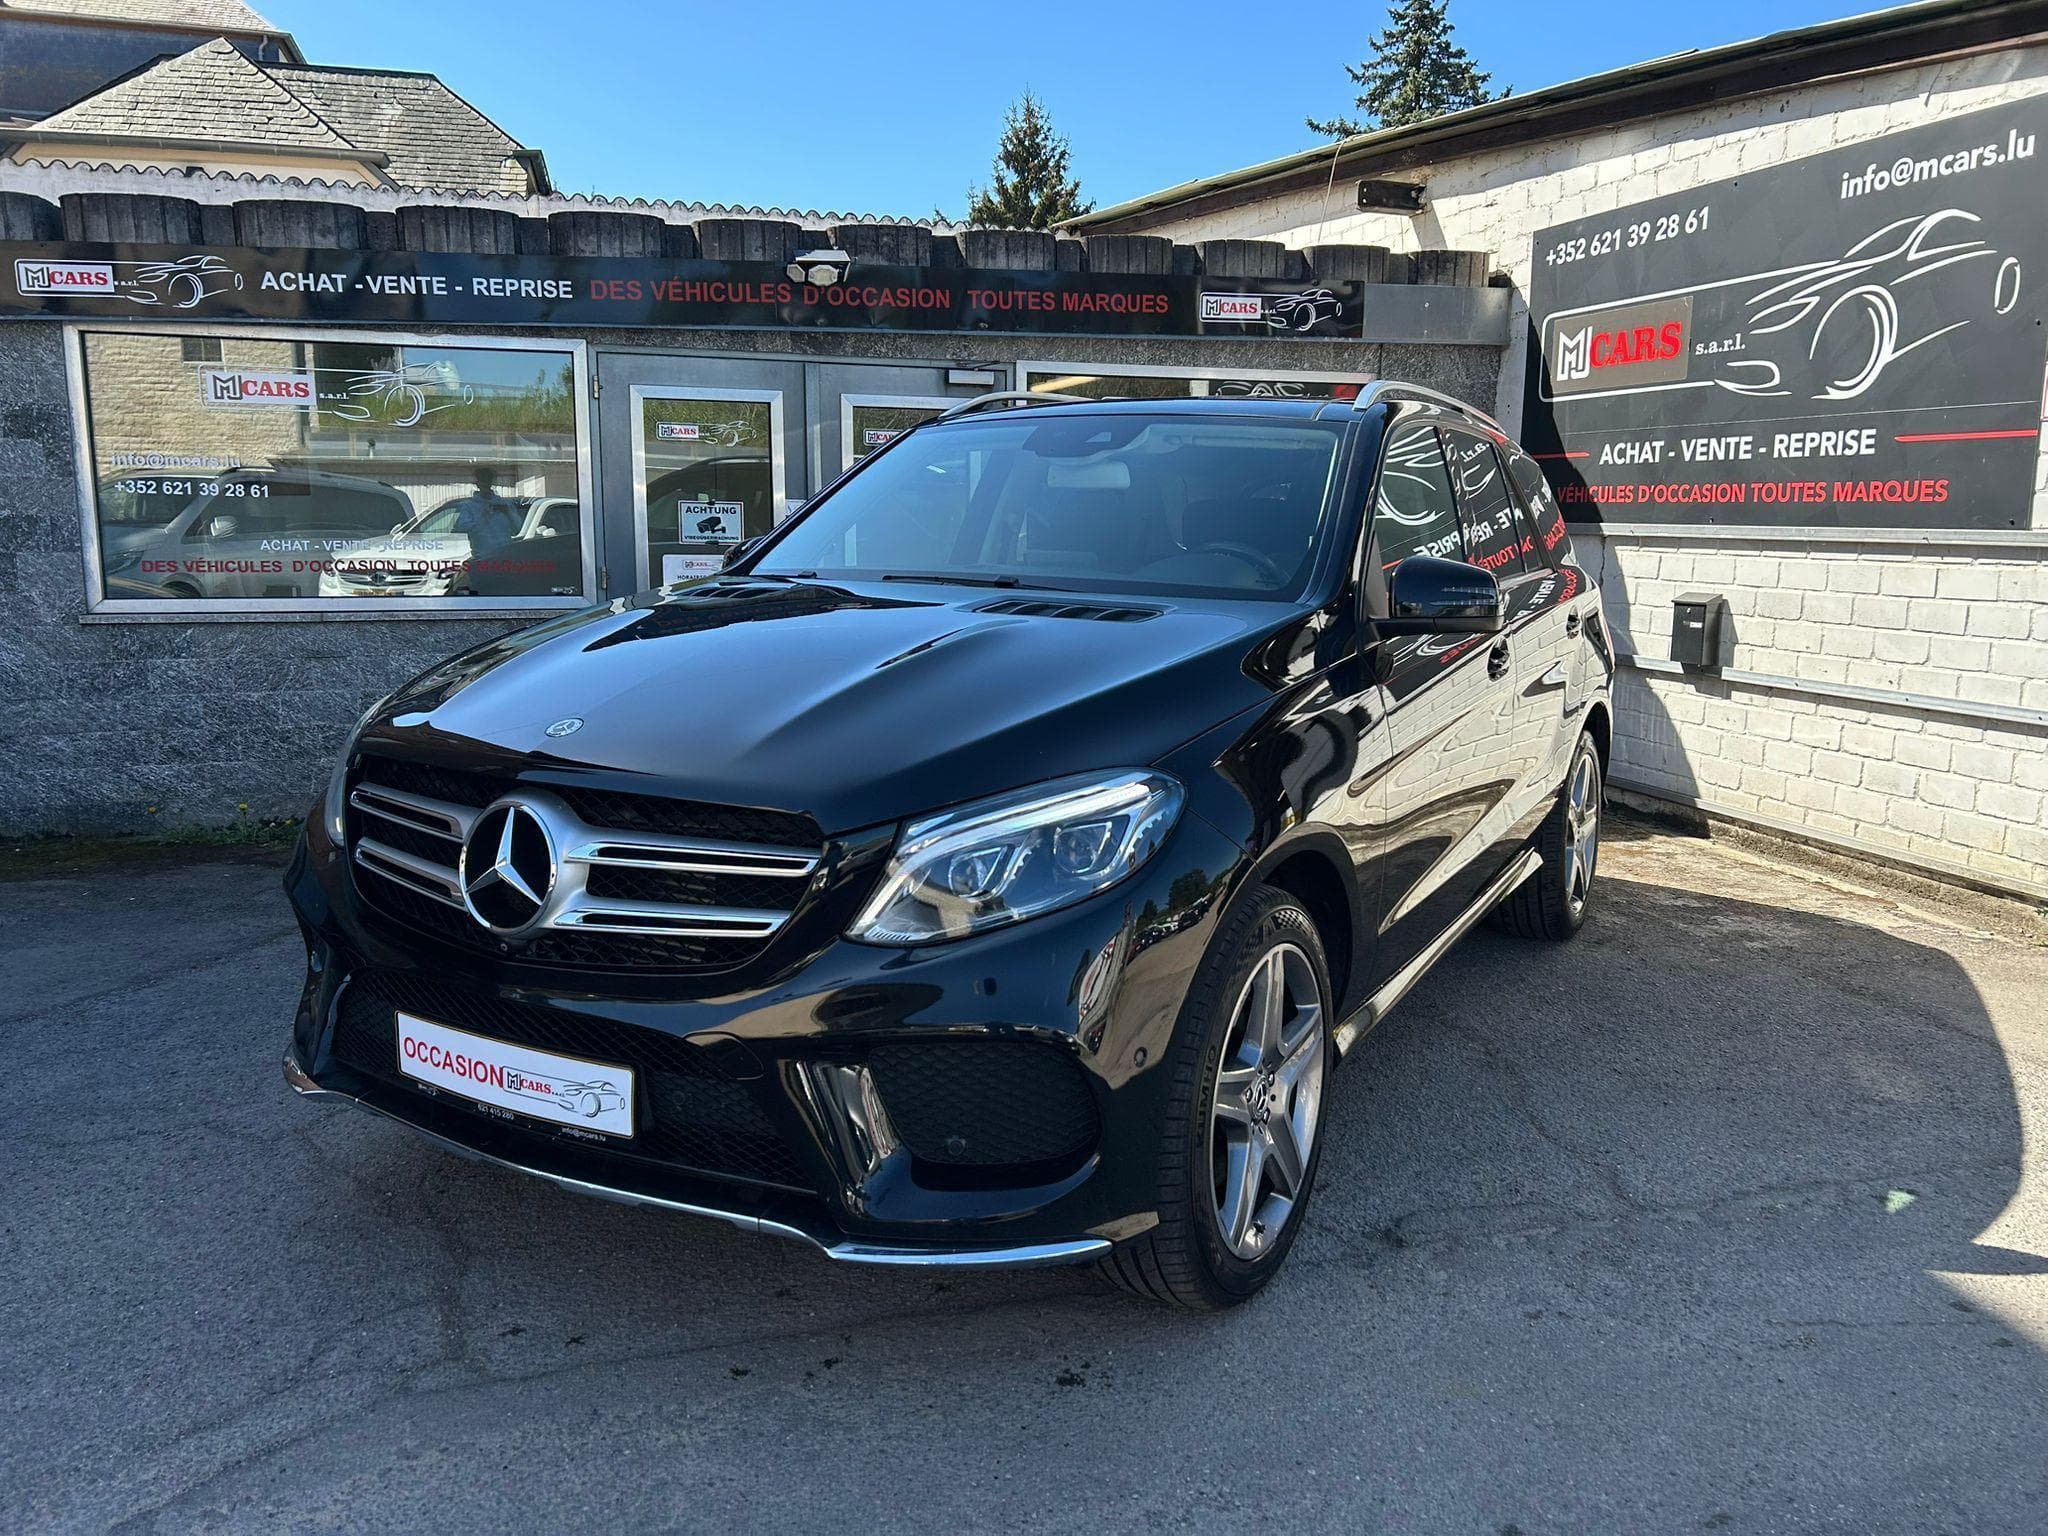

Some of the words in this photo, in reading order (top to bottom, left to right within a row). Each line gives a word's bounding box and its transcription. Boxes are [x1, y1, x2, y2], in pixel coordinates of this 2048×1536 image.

[1841, 128, 2036, 199] info@mcars.lu
[1546, 237, 1586, 266] +352
[1590, 228, 1621, 257] 621
[1627, 221, 1651, 248] 39
[1655, 213, 1680, 242] 28
[1685, 205, 1709, 234] 61
[260, 271, 346, 293] ACHAT
[472, 277, 573, 299] REPRISE
[590, 279, 643, 300] DES
[650, 276, 792, 303] VÉHICULES
[803, 284, 951, 309] D'OCCASION
[967, 290, 1056, 312] TOUTES
[1062, 292, 1169, 314] MARQUES
[1695, 333, 1746, 355] s.a.r.l.
[1599, 440, 1665, 465] ACHAT
[1681, 435, 1753, 462] VENTE
[1773, 428, 1877, 459] REPRISE
[111, 453, 241, 469] info@mcars.lu
[114, 480, 157, 494] +352
[162, 481, 192, 495] 621
[199, 482, 219, 496] 39
[225, 483, 245, 497] 28
[250, 484, 269, 498] 61
[1558, 481, 1634, 504] VÉHICULES
[1638, 482, 1746, 504] D'OCCASION
[1751, 481, 1827, 503] TOUTES
[1833, 479, 1949, 503] MARQUES
[685, 506, 737, 515] ACHTUNG
[260, 540, 310, 551] ACHAT
[322, 540, 371, 551] VENTE
[384, 540, 444, 551] REPRISE
[141, 560, 179, 573] DES
[184, 557, 283, 573] VÉHICULES
[292, 560, 397, 573] D'OCCASION
[407, 559, 471, 573] TOUTES
[403, 1037, 504, 1089] OCCASION
